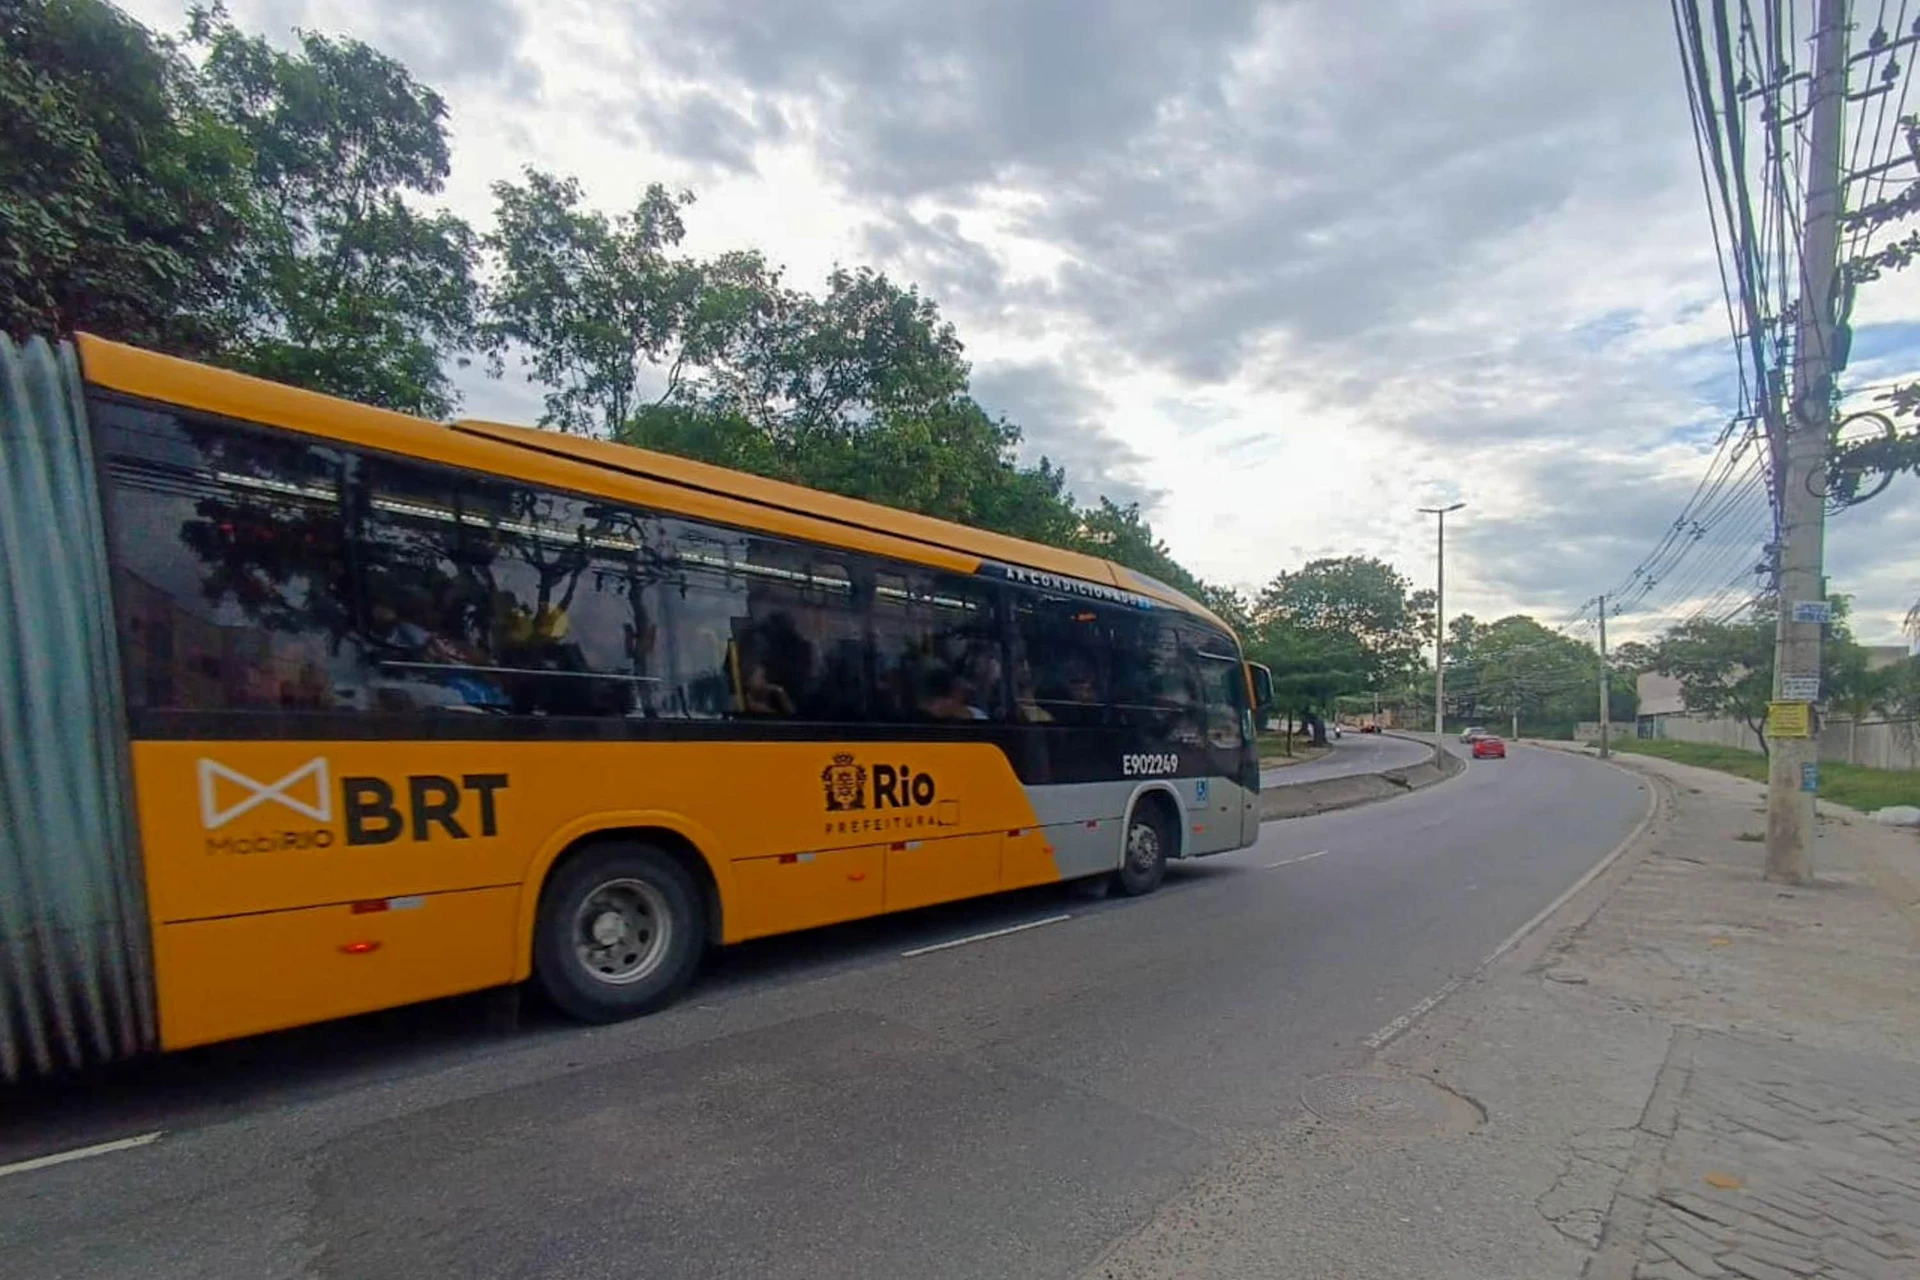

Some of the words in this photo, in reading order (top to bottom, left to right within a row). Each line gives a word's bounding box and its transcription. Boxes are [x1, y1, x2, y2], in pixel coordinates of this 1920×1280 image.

[1006, 567, 1026, 583] AR
[1122, 754, 1179, 776] E902249
[872, 764, 936, 810] Rio
[340, 773, 510, 847] BRT
[825, 815, 935, 835] PREFEITURA
